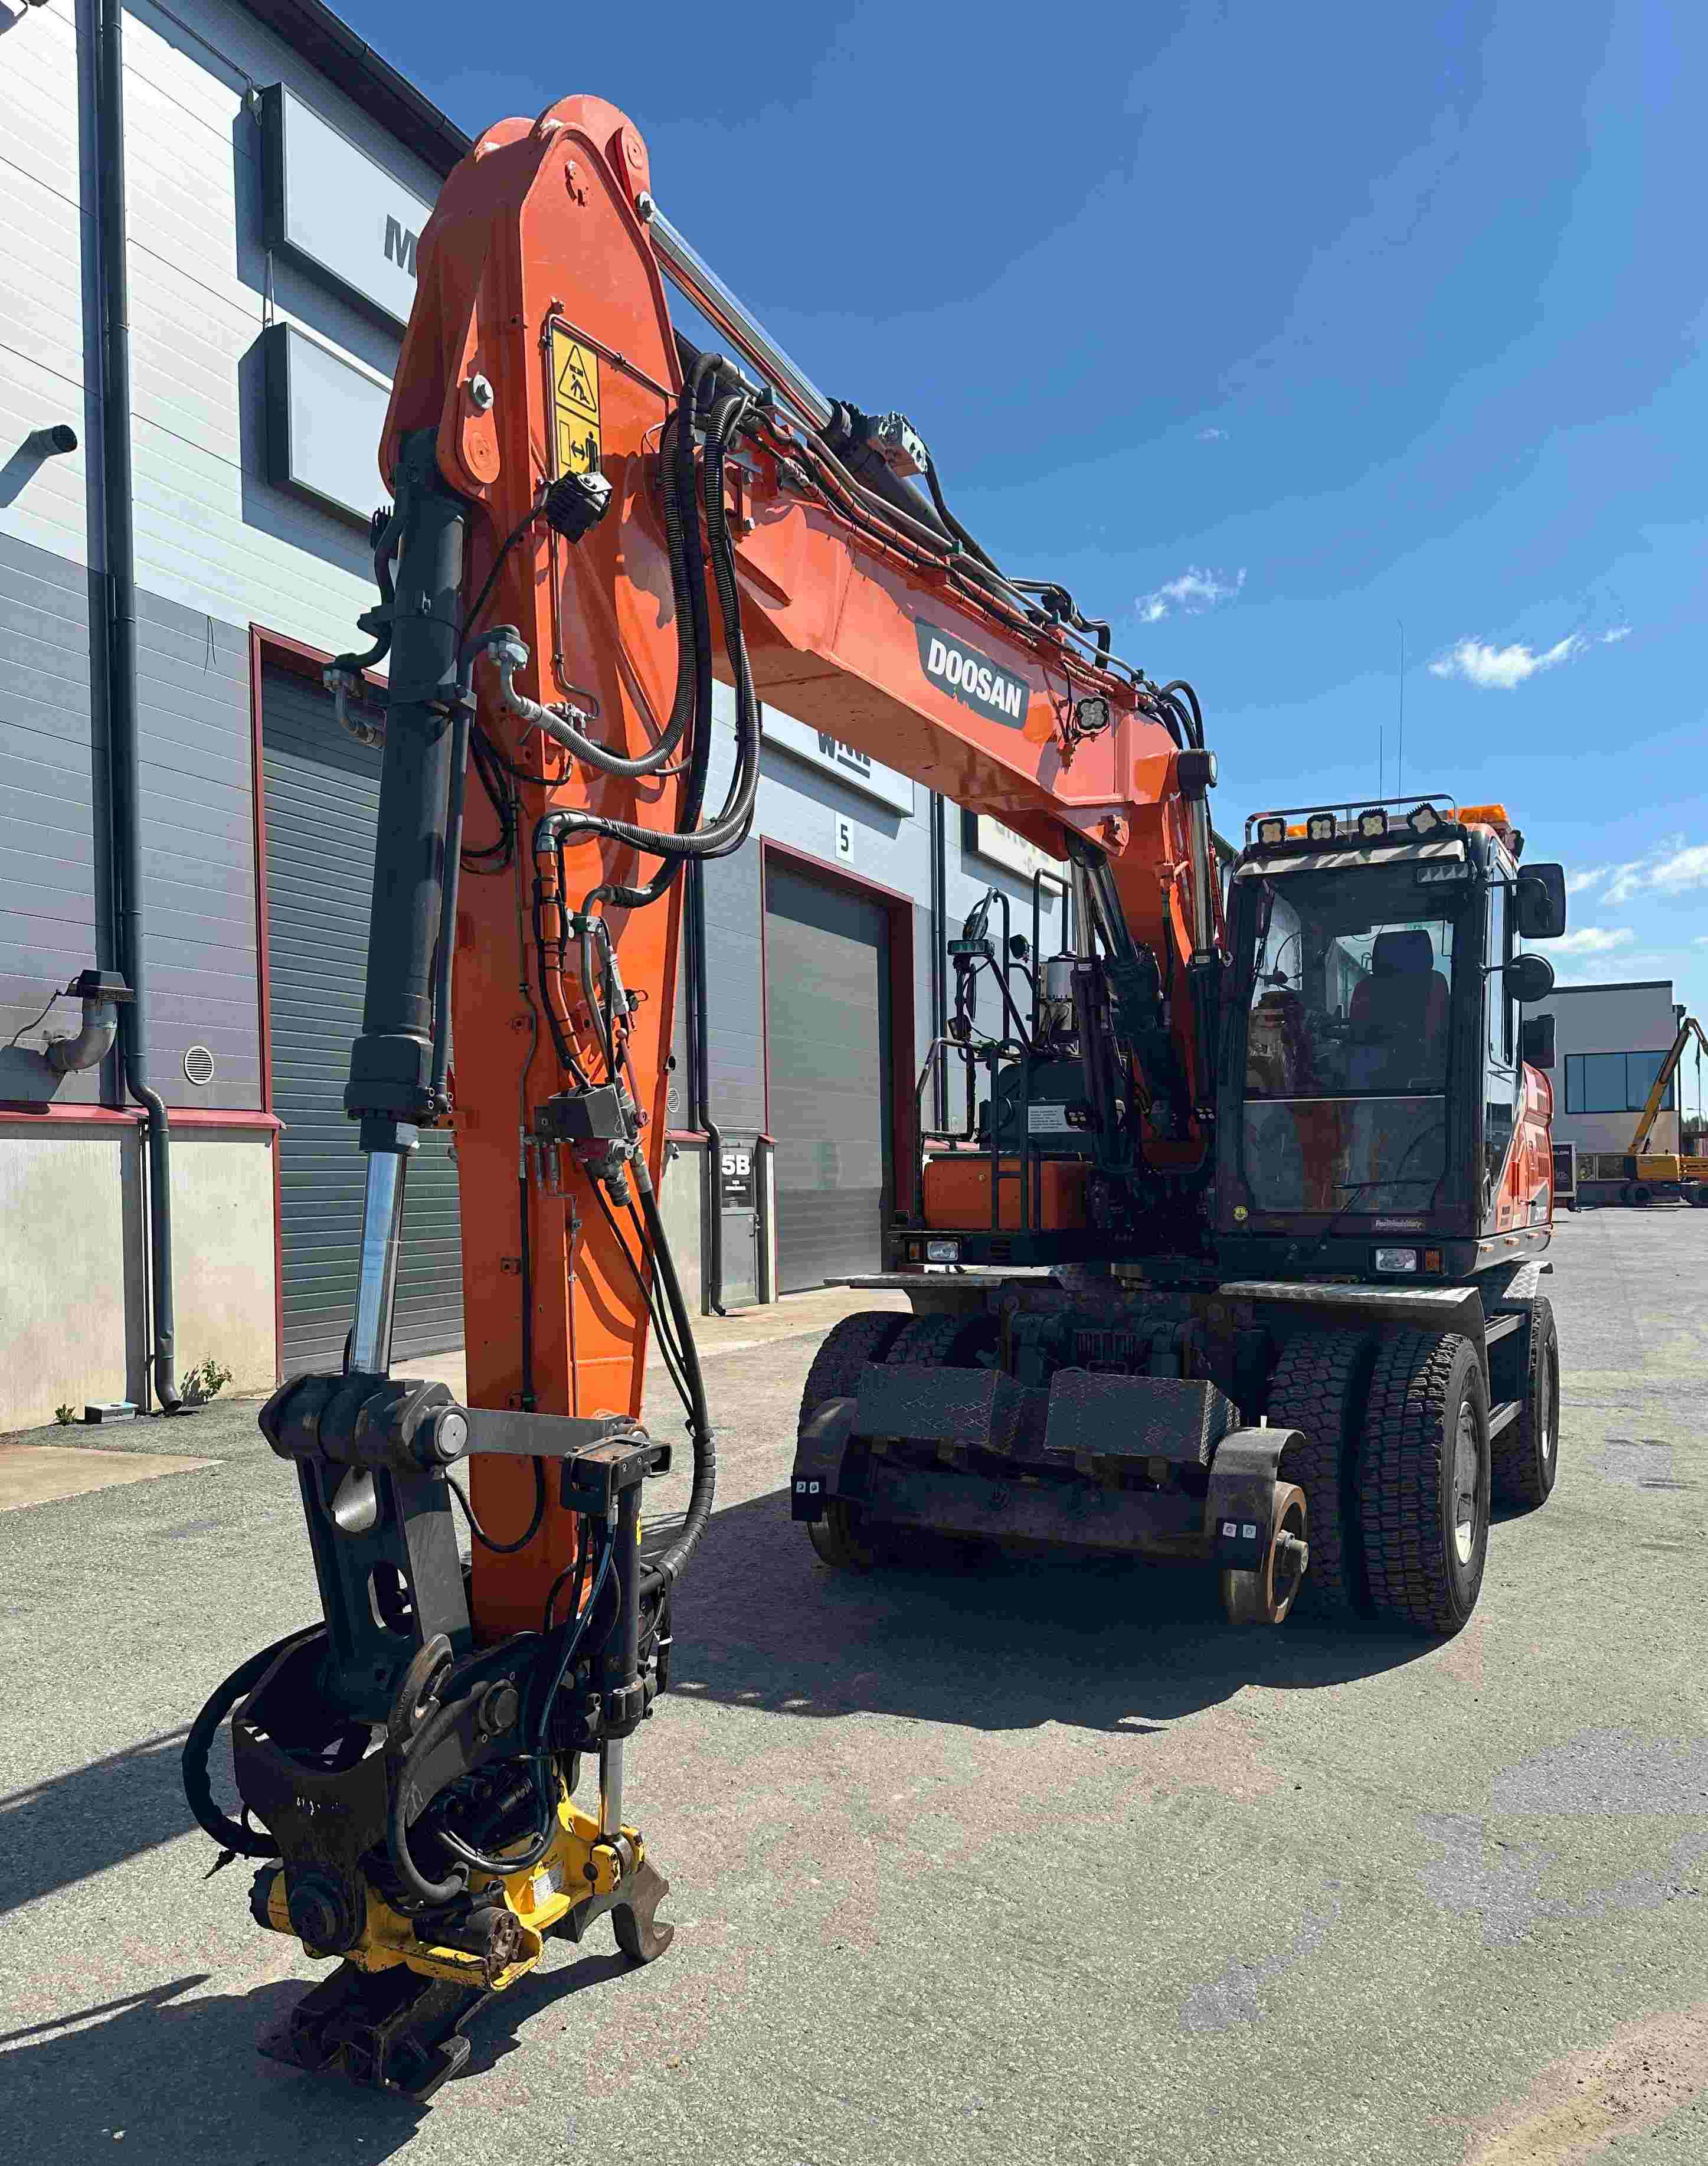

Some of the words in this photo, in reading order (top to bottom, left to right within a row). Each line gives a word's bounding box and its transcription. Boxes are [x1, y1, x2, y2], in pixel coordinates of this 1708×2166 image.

[927, 638, 1022, 718] DOOSAN
[840, 824, 849, 852] 5
[721, 1155, 751, 1175] 5B
